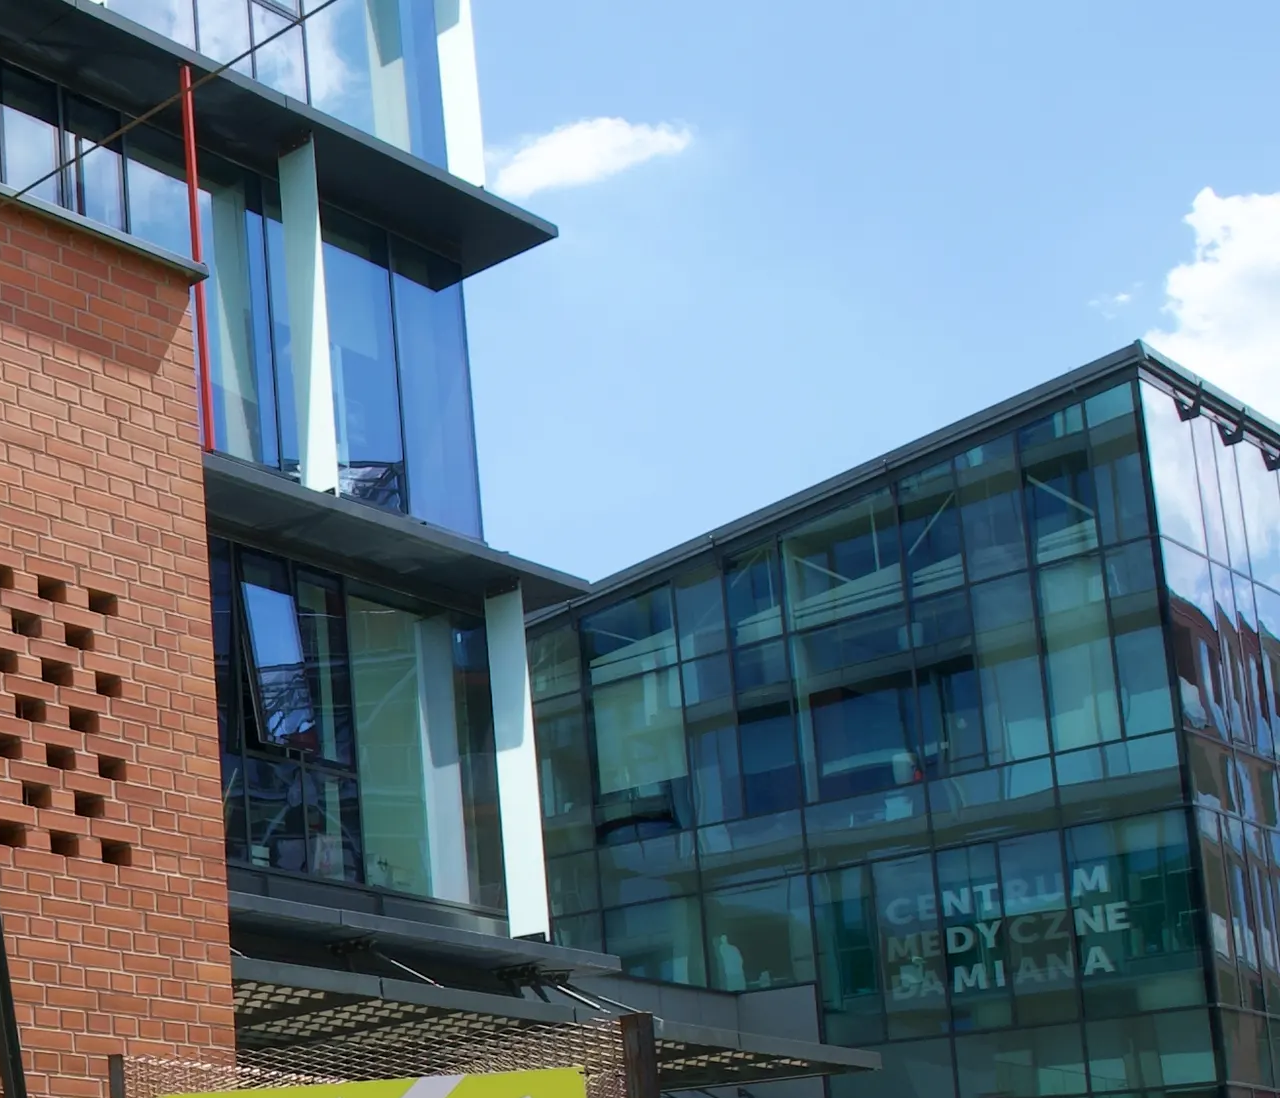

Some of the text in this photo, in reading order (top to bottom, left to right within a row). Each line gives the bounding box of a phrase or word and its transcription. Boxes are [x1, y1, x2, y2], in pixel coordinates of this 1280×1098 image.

[885, 865, 1110, 926] CENTRUM
[887, 901, 1131, 962] MEDYCZNE
[892, 946, 1115, 1000] DAMIANA
